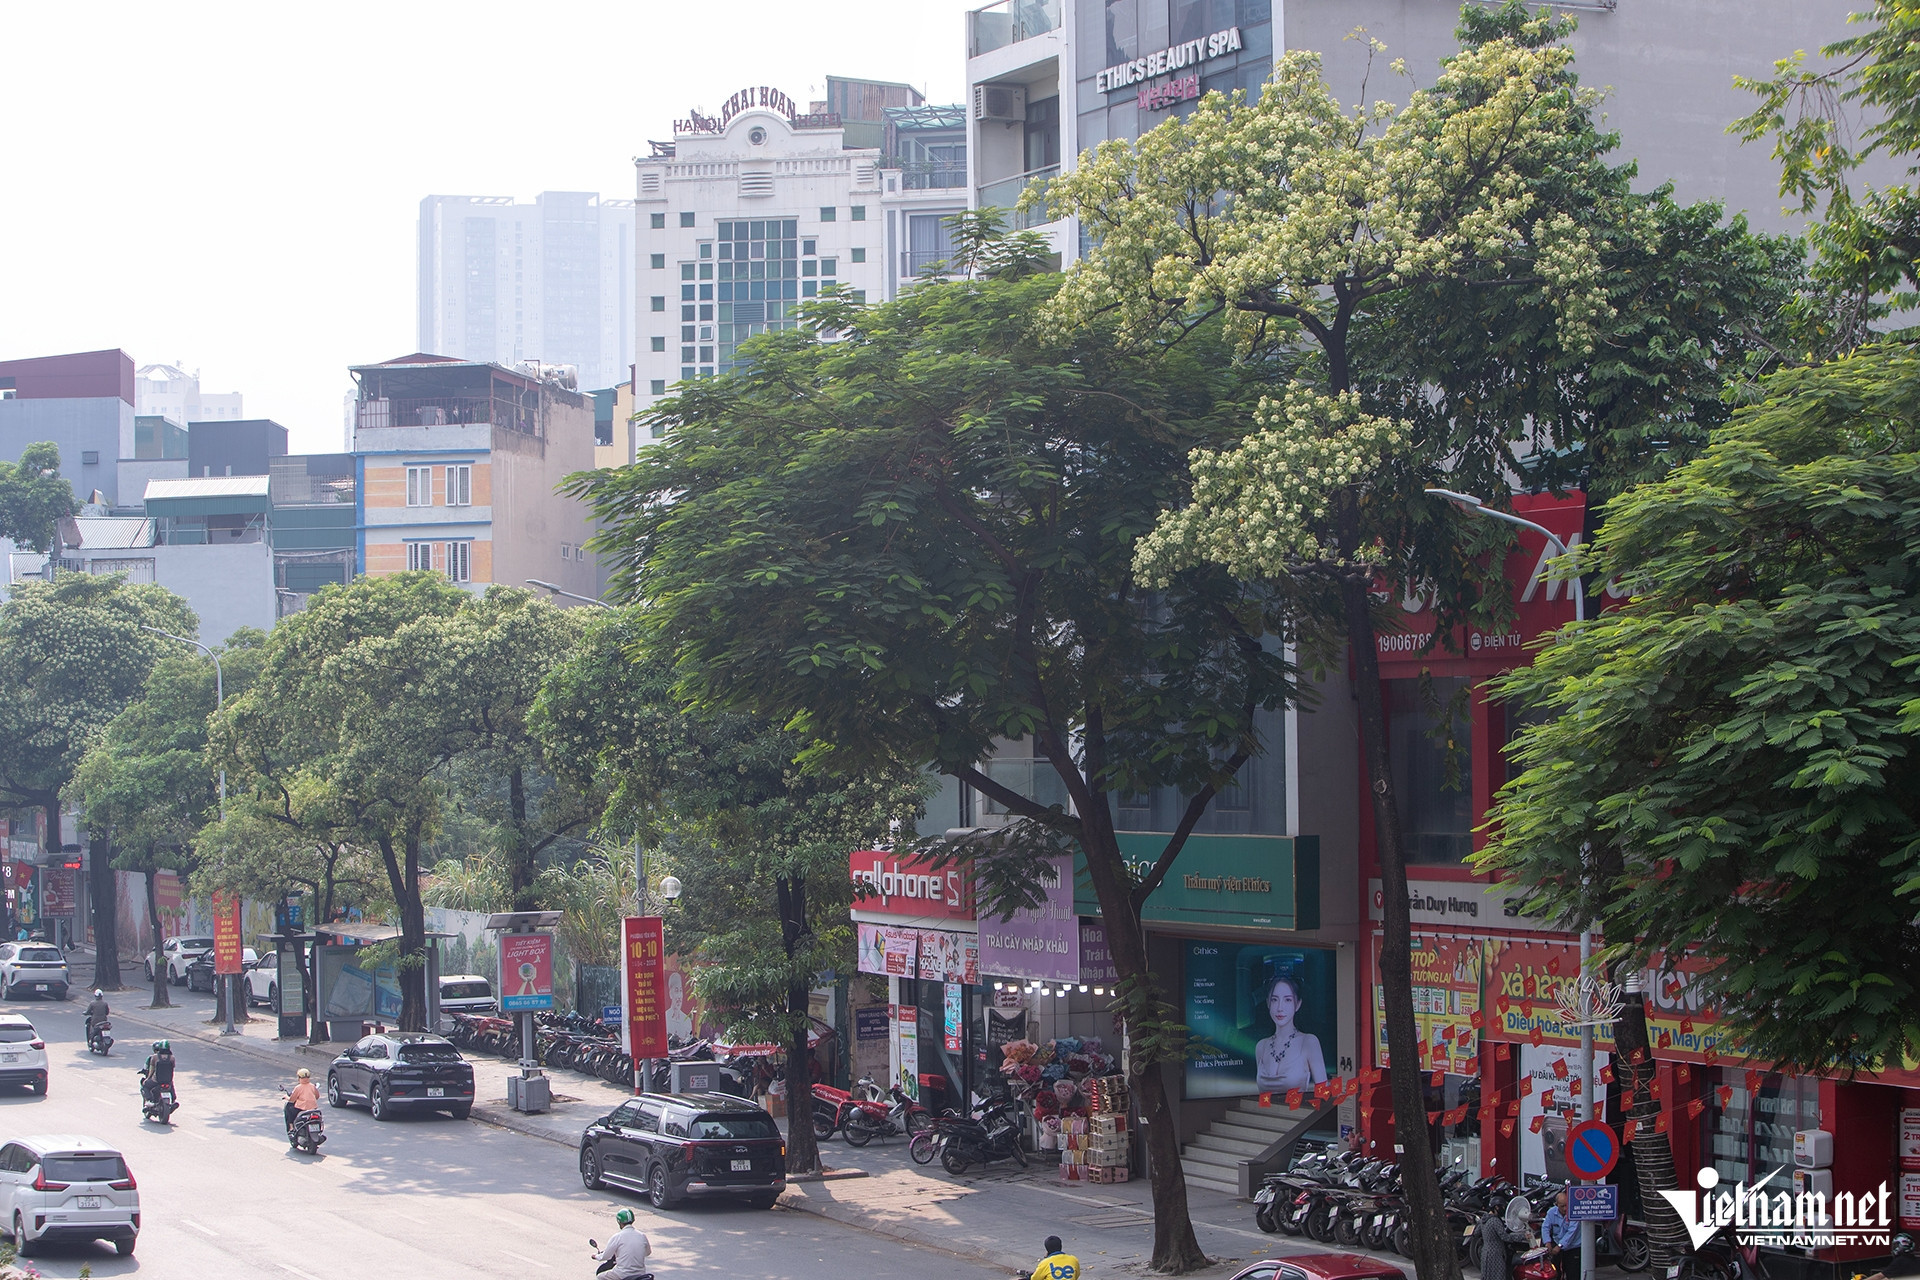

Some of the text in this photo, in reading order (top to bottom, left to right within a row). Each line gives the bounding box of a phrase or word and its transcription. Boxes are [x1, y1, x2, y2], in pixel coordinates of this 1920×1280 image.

[1096, 26, 1243, 94] ETHICS BEAUTY SPA
[721, 86, 797, 126] KHAI HOAN
[1484, 634, 1506, 650] ĐIỆN
[1183, 871, 1208, 890] Thẩm
[1223, 875, 1242, 893] viện
[1242, 875, 1271, 892] Ethics
[1409, 889, 1426, 910] rần
[1426, 896, 1447, 916] Duy
[1448, 896, 1478, 917] Hưng
[986, 931, 1003, 948] TRÁI
[1004, 934, 1021, 950] CÂY
[1022, 937, 1044, 954] NHẬP
[1046, 932, 1069, 954] KHẨU
[1082, 928, 1103, 943] Hoa
[507, 947, 547, 958] LIGHT BOX
[1085, 949, 1104, 961] Trái
[1410, 951, 1436, 967] PTOP
[1080, 967, 1104, 981] Nhập
[1440, 972, 1452, 984] LAI
[1501, 963, 1524, 998] xả
[1050, 1262, 1075, 1280] be
